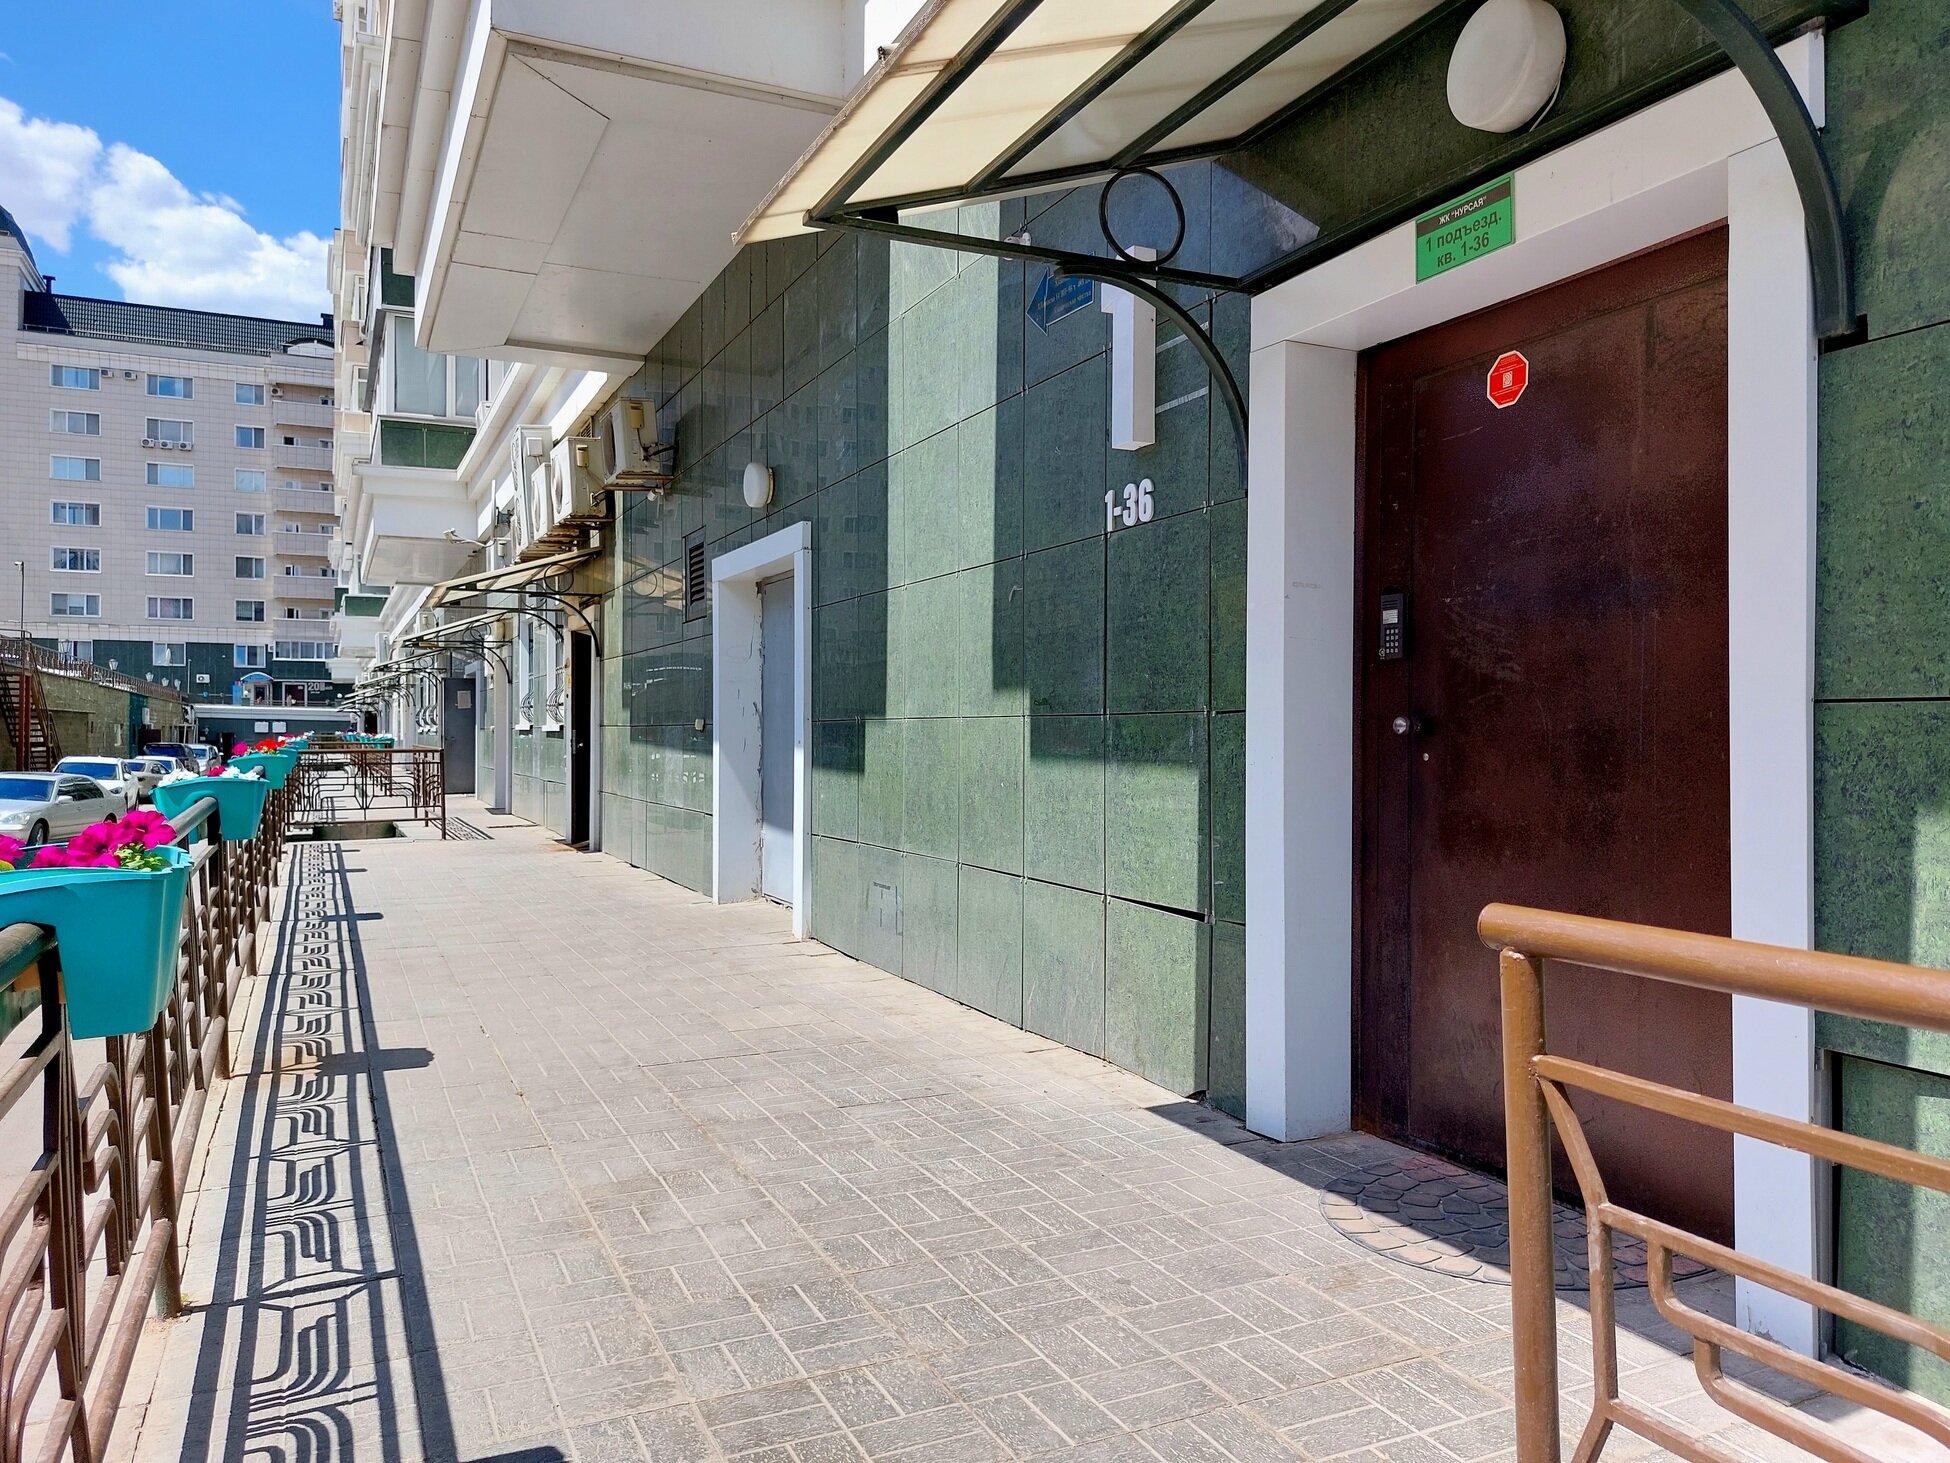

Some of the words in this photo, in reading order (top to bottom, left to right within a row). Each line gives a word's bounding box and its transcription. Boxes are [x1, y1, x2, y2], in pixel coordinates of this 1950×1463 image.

[1426, 237, 1432, 253] 1
[1437, 211, 1502, 248] подъезд.
[1438, 213, 1451, 225] ЖК
[1437, 252, 1456, 268] кв.
[1461, 232, 1490, 257] 1-36
[1105, 478, 1155, 532] 1-36
